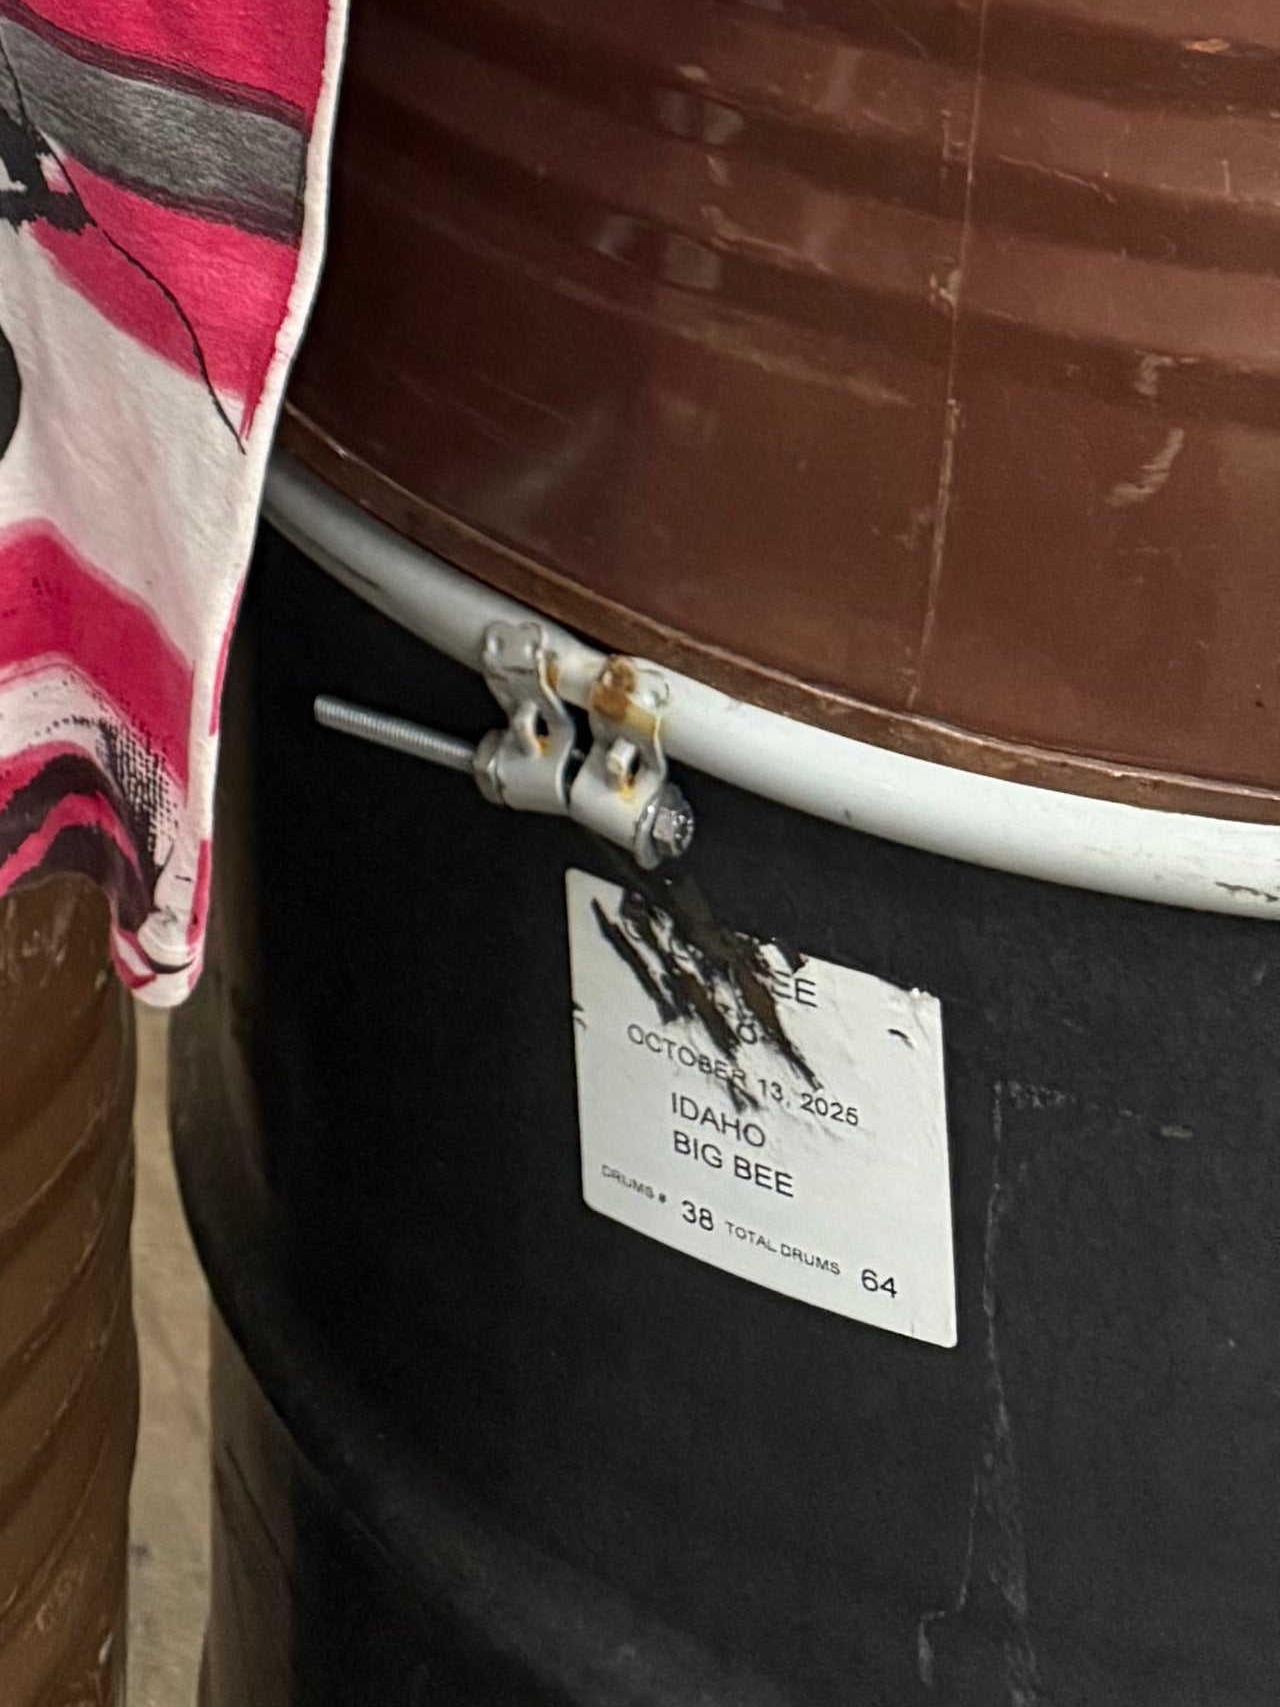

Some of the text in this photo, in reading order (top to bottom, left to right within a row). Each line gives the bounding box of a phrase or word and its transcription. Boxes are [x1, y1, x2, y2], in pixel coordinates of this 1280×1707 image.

[627, 1022, 748, 1087] OCTOBER
[756, 1075, 792, 1107] 13,
[801, 1092, 860, 1127] 2025
[670, 1091, 767, 1149] IDAHO
[673, 1130, 795, 1198] BIG BEE
[601, 1163, 656, 1202] DRUMS
[680, 1199, 715, 1232] 38
[724, 1220, 776, 1253] TOTAL
[779, 1242, 842, 1276] DRUMS
[860, 1268, 898, 1299] 64
